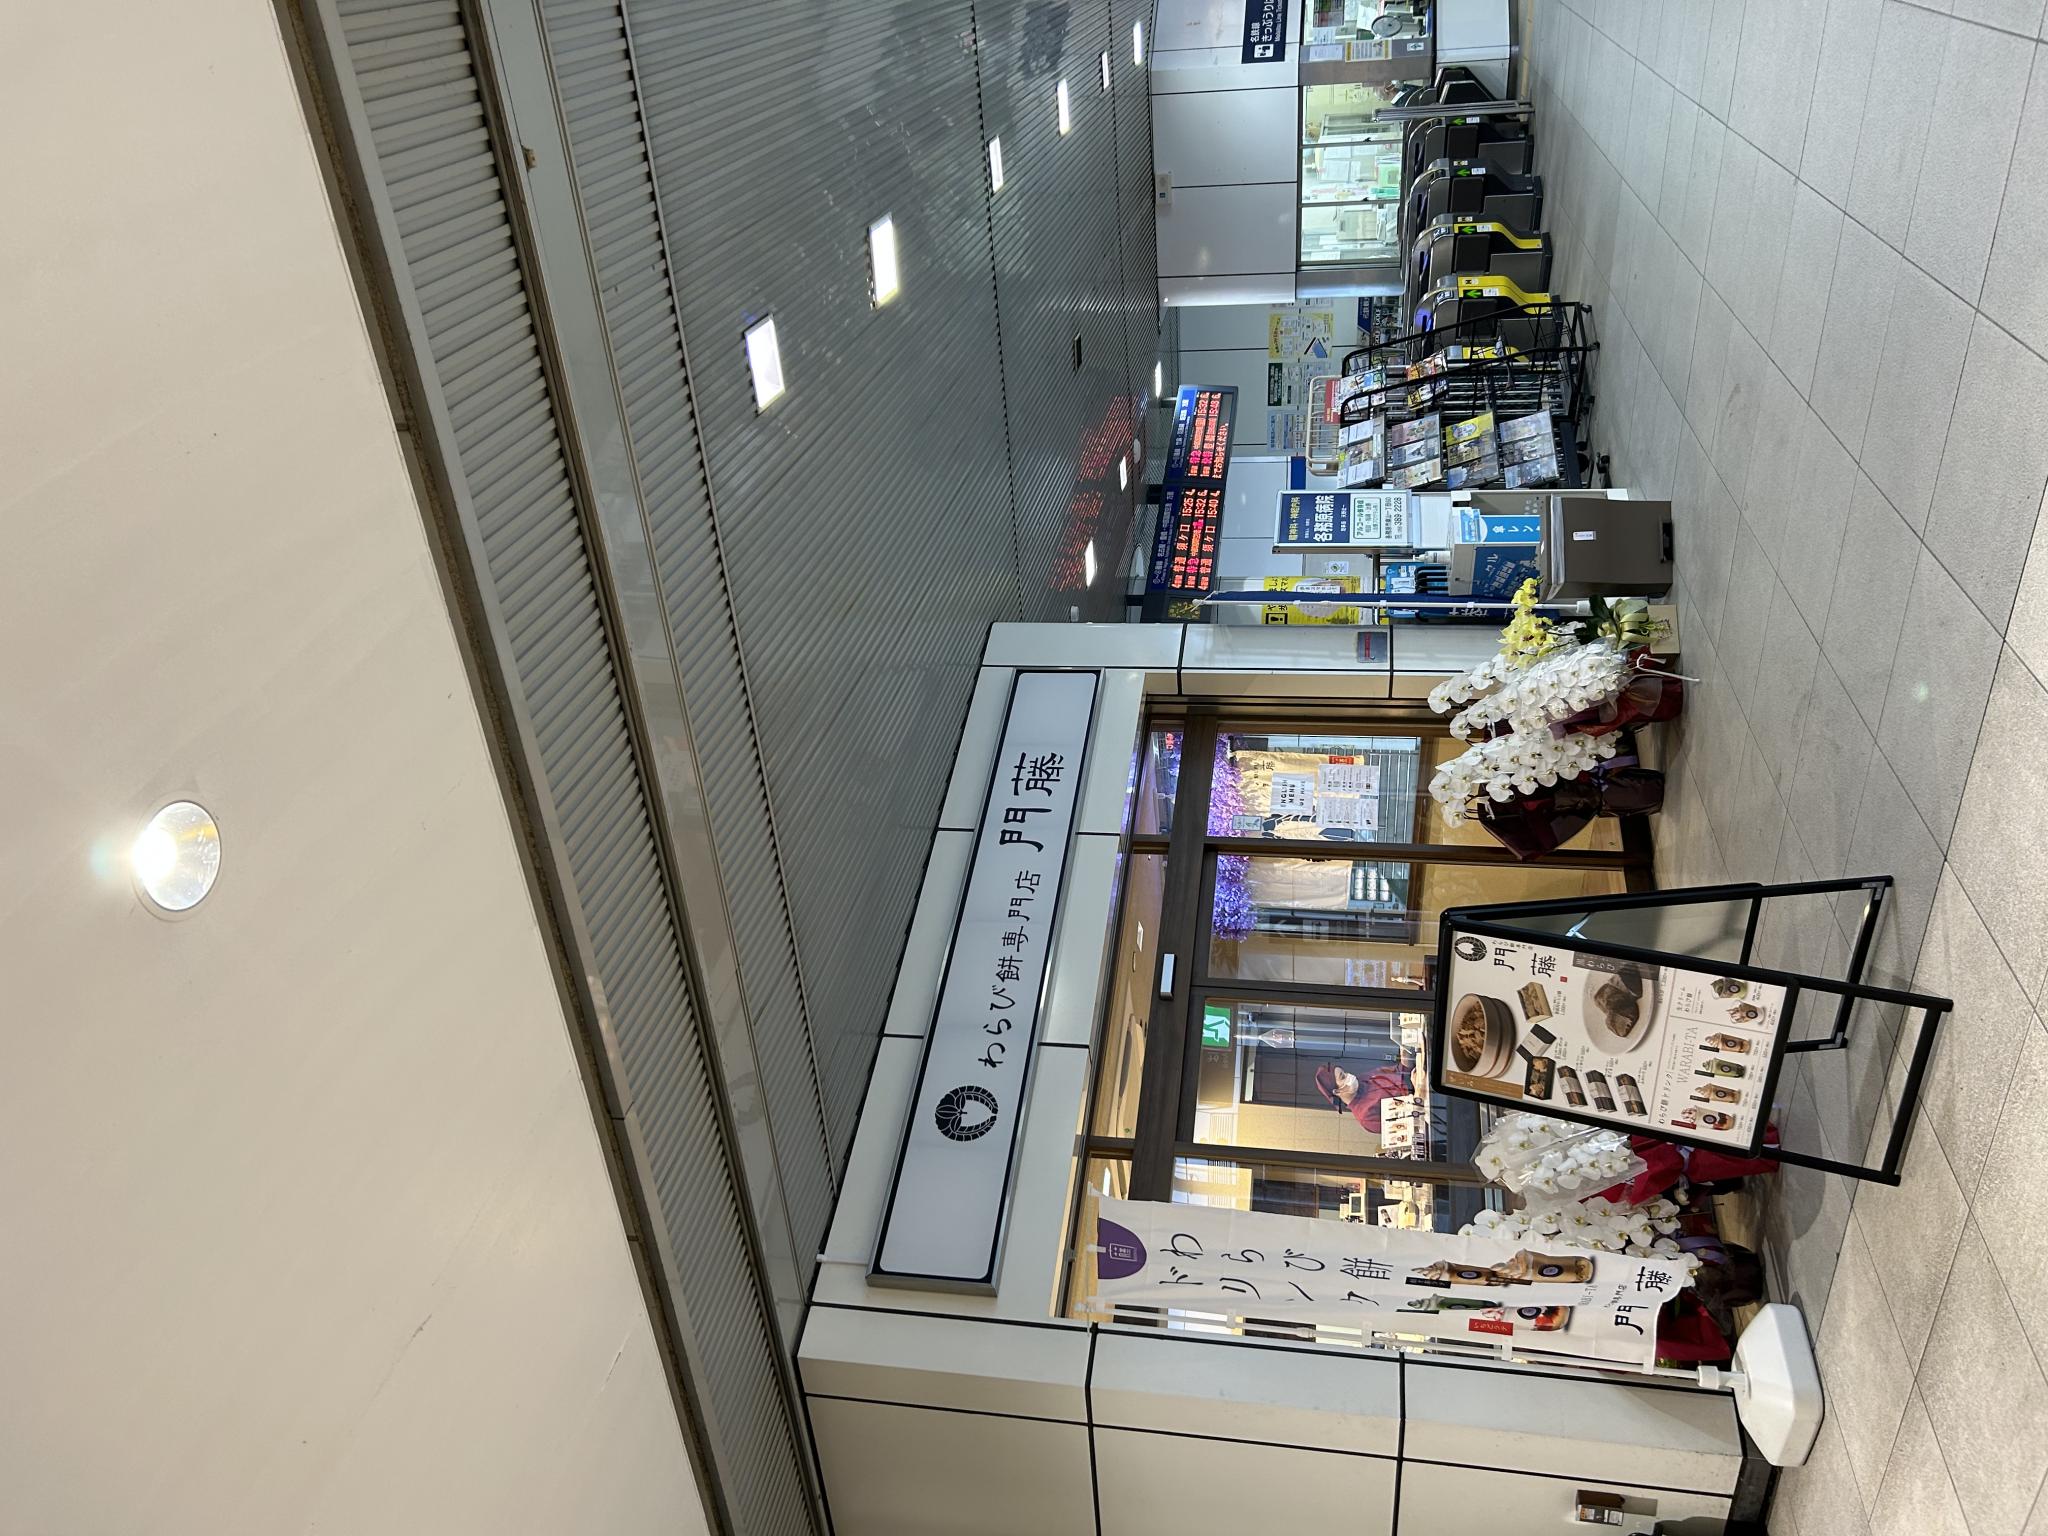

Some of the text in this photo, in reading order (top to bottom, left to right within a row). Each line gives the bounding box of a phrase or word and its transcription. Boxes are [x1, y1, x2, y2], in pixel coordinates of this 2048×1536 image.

[1188, 450, 1202, 464] 特急
[1172, 556, 1186, 572] 普通
[1182, 498, 1194, 516] 15:25
[1186, 558, 1200, 573] 特急
[1194, 498, 1206, 517] 15:32
[1199, 558, 1212, 574] 普通
[1207, 499, 1219, 518] 15:40
[1313, 494, 1334, 542] 各務原病院
[1288, 784, 1296, 803] MENU
[978, 751, 1065, 1068] わらび餅専門店 門藤
[1494, 948, 1556, 978] 門藤
[1676, 1026, 1698, 1083] WARABI-TA
[1160, 1233, 1394, 1280] わらび餅
[1159, 1266, 1380, 1306] ドリンク
[1614, 1266, 1672, 1335] 門藤
